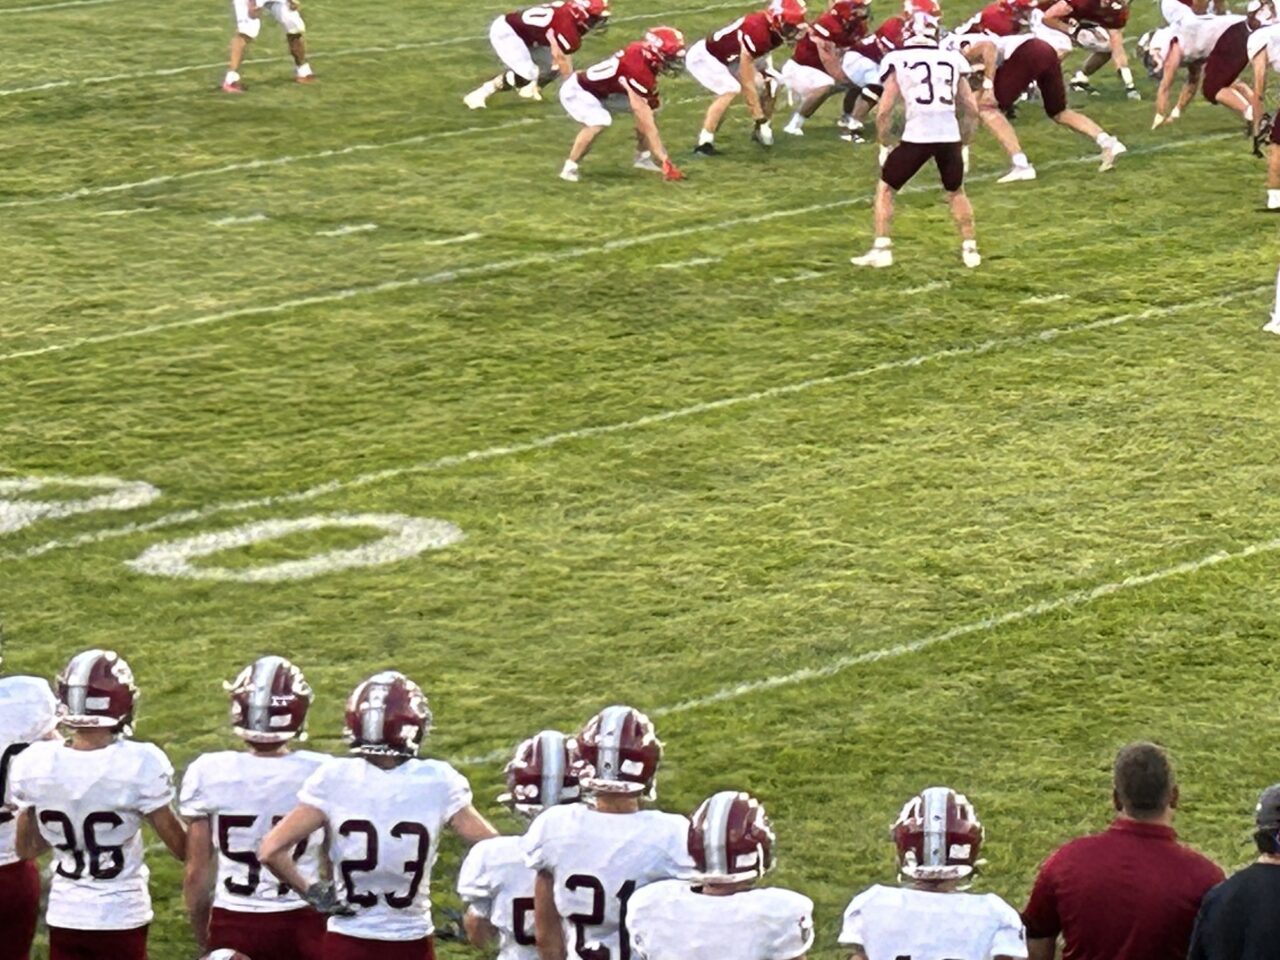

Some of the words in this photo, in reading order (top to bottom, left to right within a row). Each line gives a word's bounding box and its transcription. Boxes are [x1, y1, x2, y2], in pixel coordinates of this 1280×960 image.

[904, 60, 955, 106] 33
[38, 809, 126, 880] 36
[338, 819, 430, 909] 23
[564, 873, 636, 960] 21
